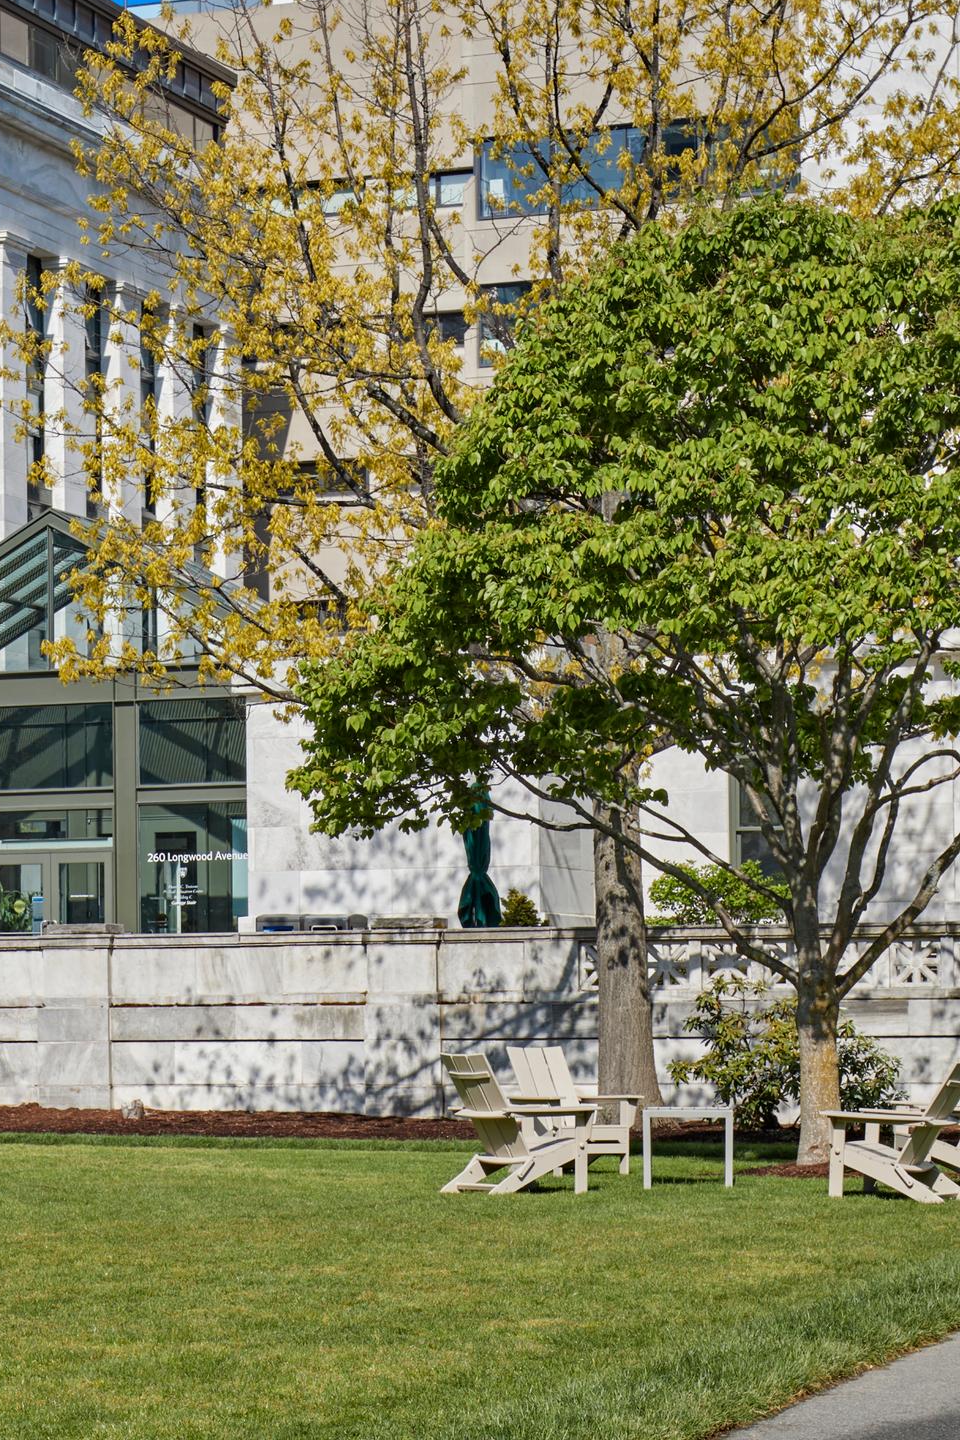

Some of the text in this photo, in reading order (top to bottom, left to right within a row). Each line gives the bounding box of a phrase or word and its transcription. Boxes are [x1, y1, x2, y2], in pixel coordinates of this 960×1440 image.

[147, 850, 249, 863] 260 Longwood Avenue
